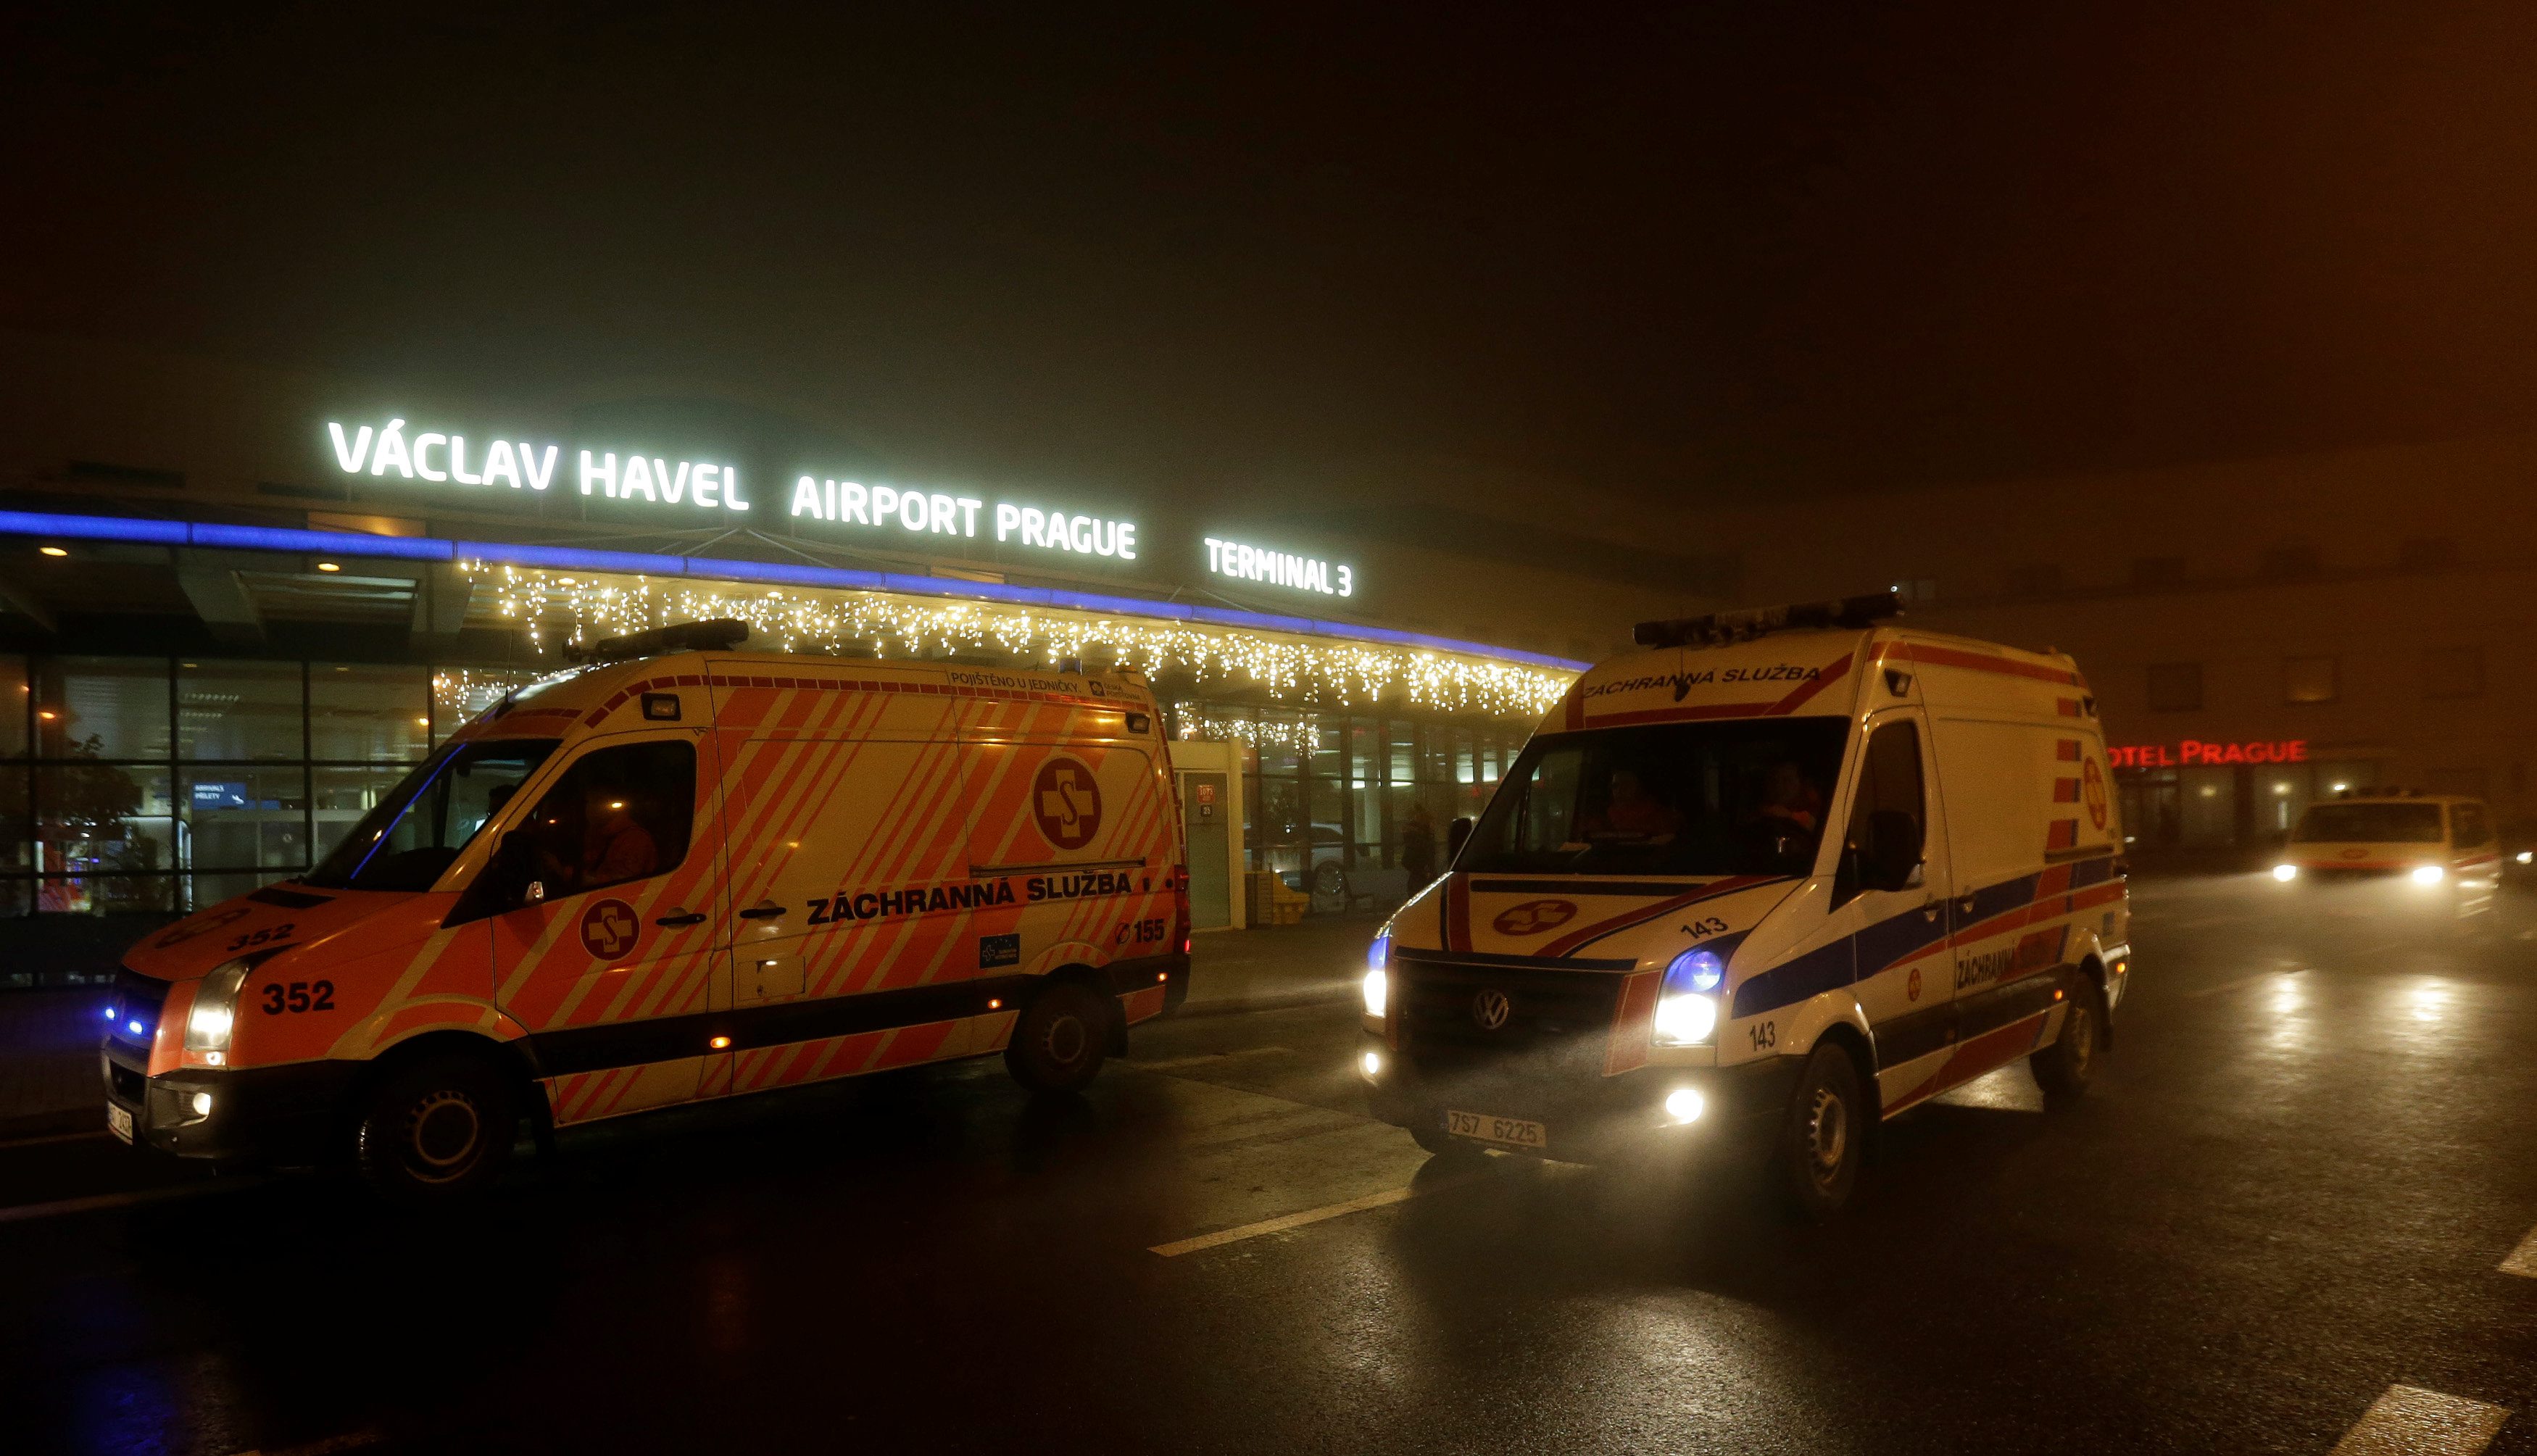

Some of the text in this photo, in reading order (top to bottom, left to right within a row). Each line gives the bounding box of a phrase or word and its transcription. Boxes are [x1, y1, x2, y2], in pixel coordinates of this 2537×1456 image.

[328, 418, 1353, 597] VÁCLAV HAVEL AIRPORT PRAGUE TERMINAL 3
[951, 672, 1015, 688] POJIŠTĚNO
[1018, 678, 1026, 689] U
[1722, 662, 1821, 683] SLUŽBA
[2107, 739, 2308, 768] OTEL PRAGUE
[807, 870, 1132, 925] ZÁCHRANNÁ SLUŽBA
[227, 923, 296, 952] 352
[1134, 918, 1165, 943] 155
[1680, 916, 1729, 939] 143
[262, 979, 336, 1016] 352
[1750, 1020, 1776, 1052] 143
[1450, 1111, 1538, 1144] 7S7 6225
